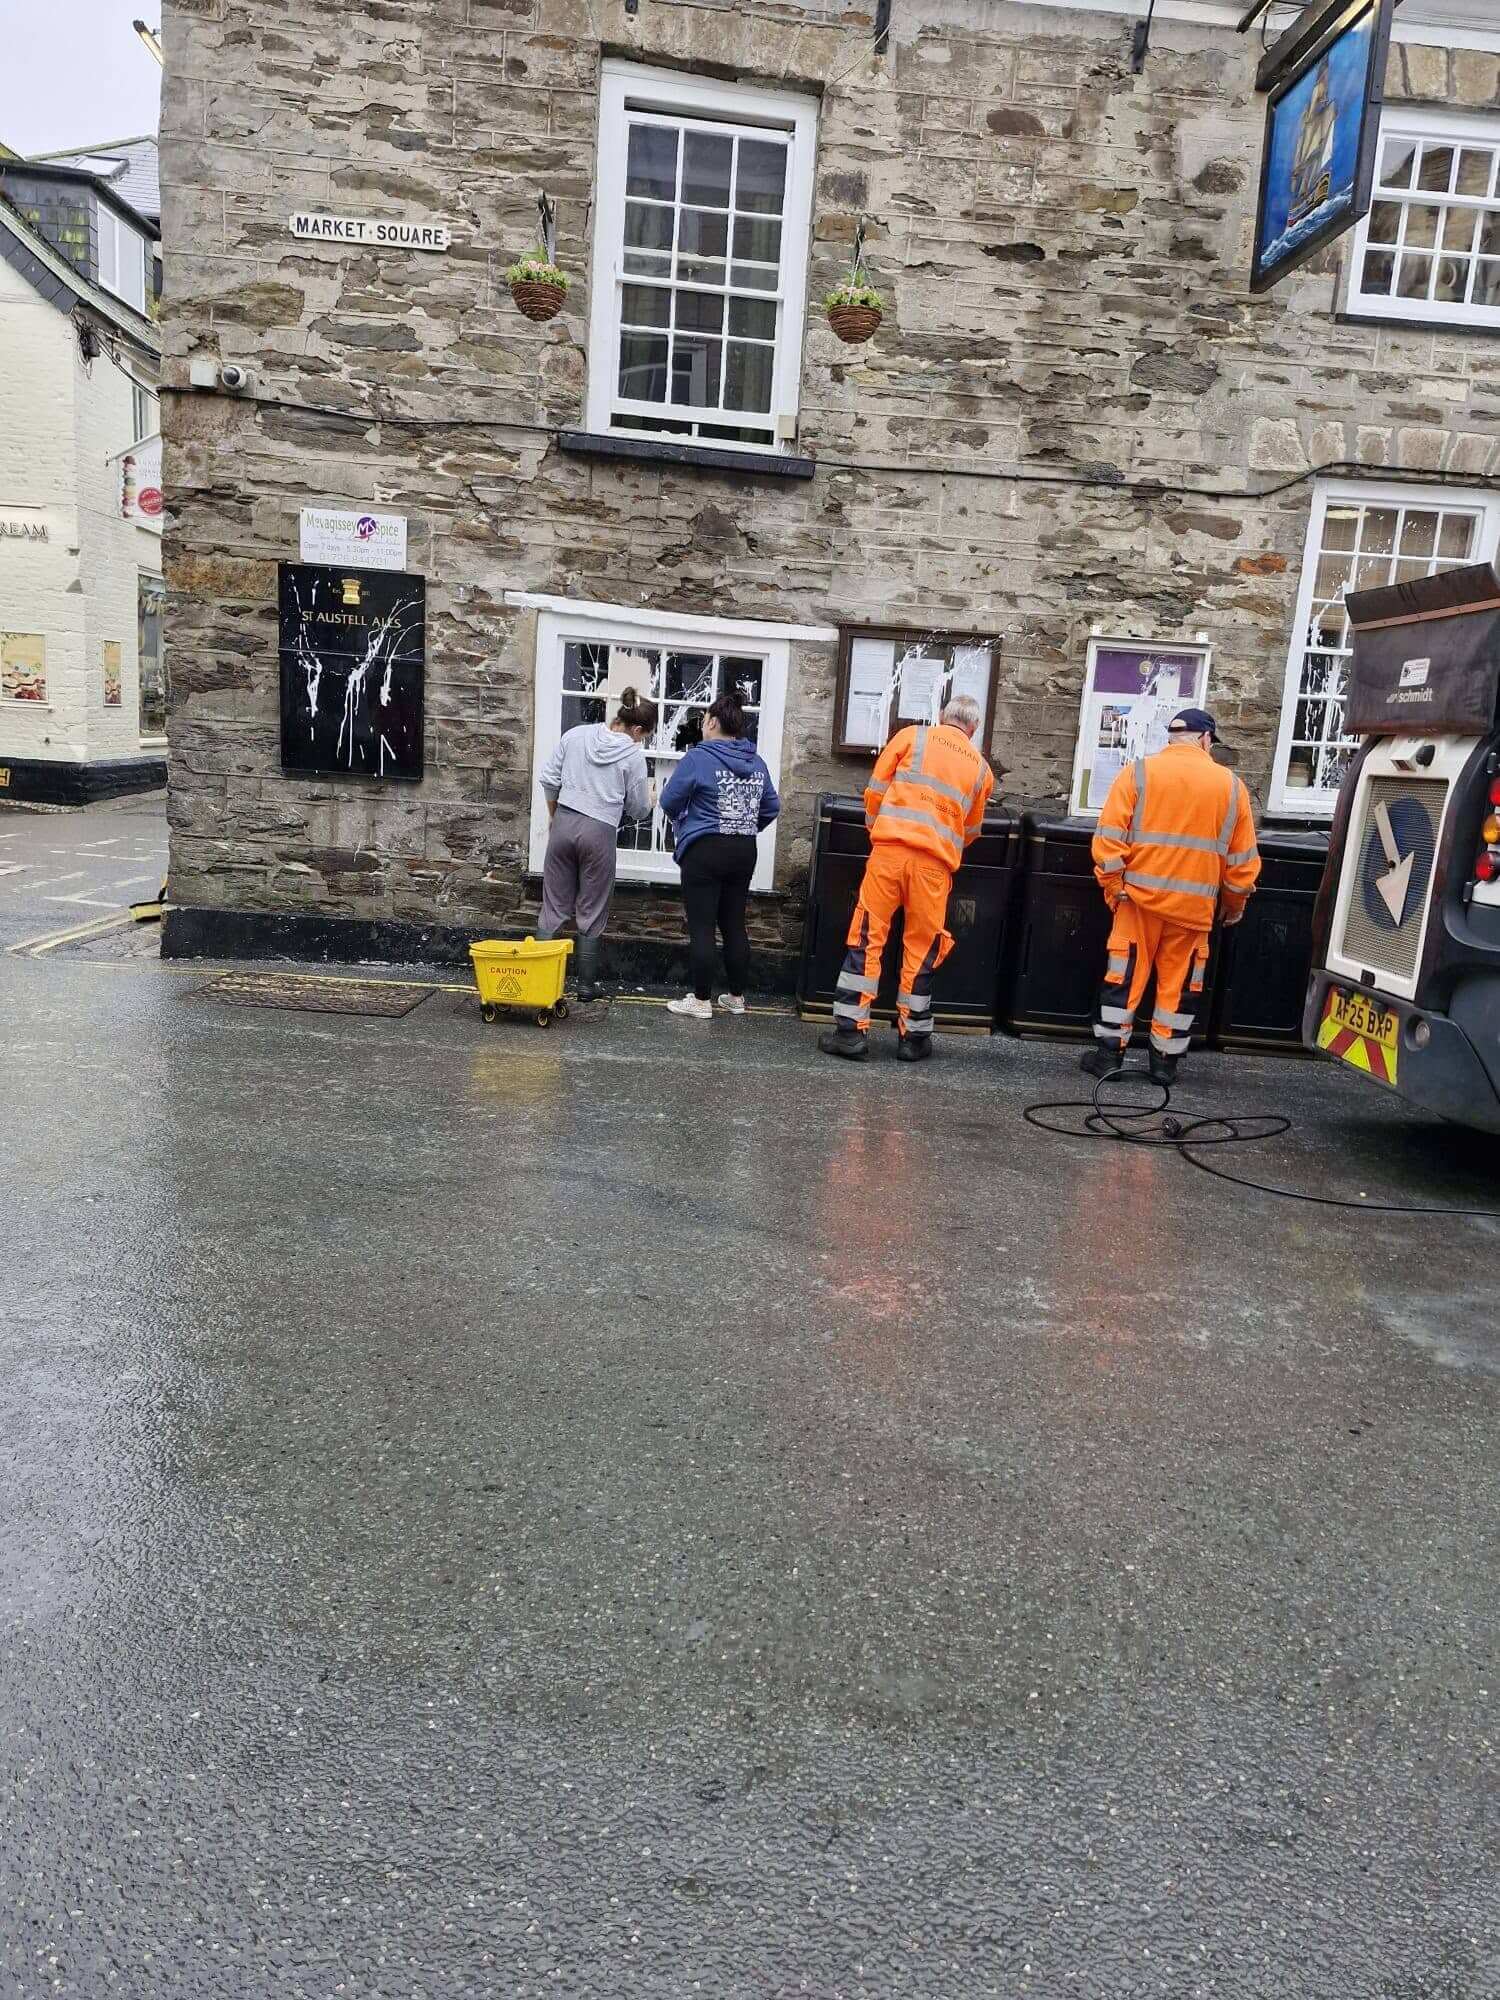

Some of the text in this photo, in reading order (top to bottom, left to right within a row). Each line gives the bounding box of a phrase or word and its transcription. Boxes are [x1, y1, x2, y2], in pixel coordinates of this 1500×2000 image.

[296, 217, 444, 246] MARKET SQUARE
[306, 513, 356, 535] Mevagissey
[301, 610, 402, 629] ST AUSTELL ALS
[1399, 688, 1433, 703] schmidt
[490, 966, 527, 975] CAUTION
[1336, 998, 1393, 1040] AF25 BXP
